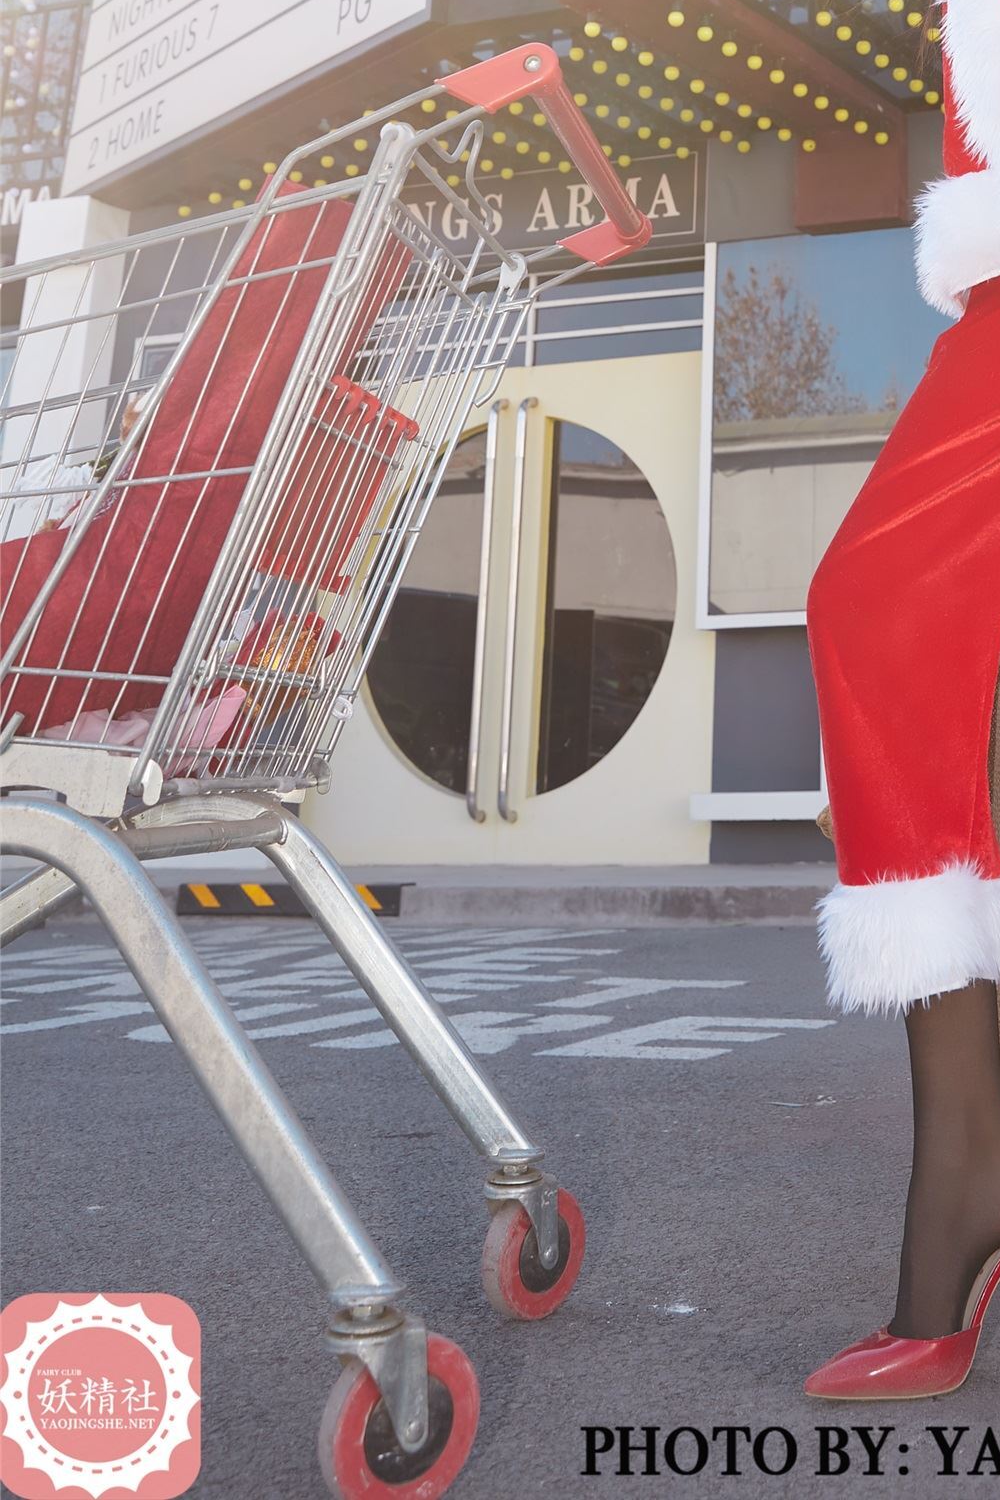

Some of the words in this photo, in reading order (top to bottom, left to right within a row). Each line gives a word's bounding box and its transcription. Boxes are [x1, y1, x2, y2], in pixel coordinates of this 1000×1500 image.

[113, 18, 198, 95] FURIOUS
[207, 4, 219, 39] 7
[88, 137, 99, 170] 2
[105, 100, 165, 160] HOME
